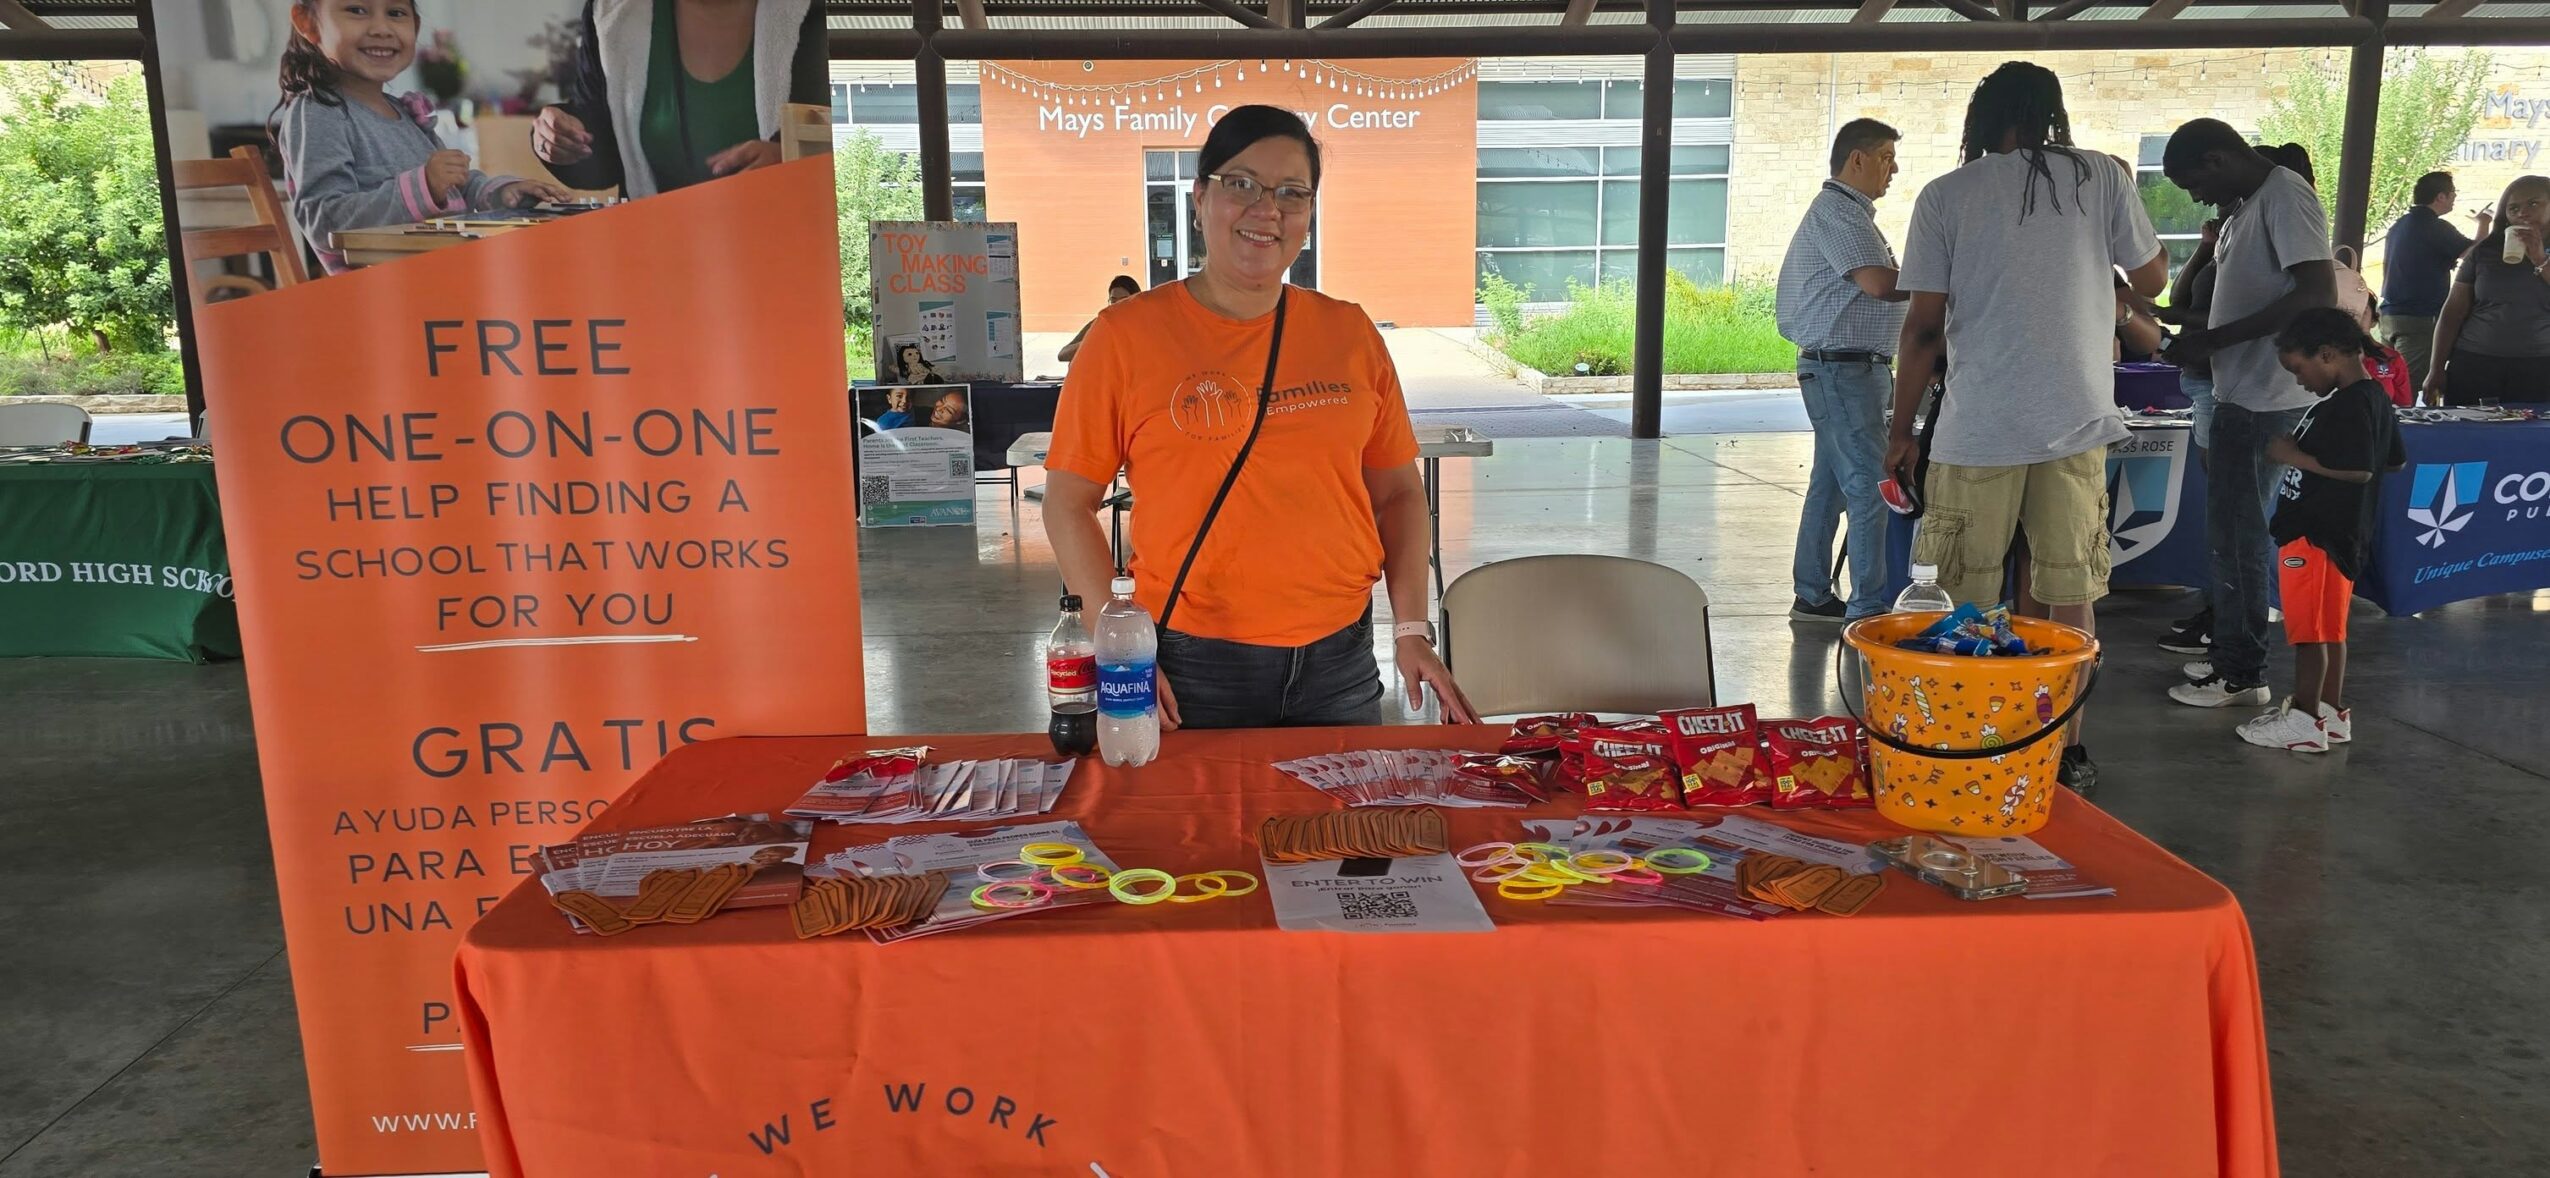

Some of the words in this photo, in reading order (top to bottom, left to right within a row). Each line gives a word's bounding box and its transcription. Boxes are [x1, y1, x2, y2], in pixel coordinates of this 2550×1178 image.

[1039, 105, 1104, 138] Mays
[1115, 104, 1197, 138] Family
[1327, 104, 1420, 129] Center
[882, 233, 928, 254] TOY
[902, 254, 988, 275] MAKING
[889, 273, 966, 294] CLASS
[424, 319, 631, 377] FREE
[1266, 396, 1348, 416] Empowered
[280, 407, 781, 464] ONE-ON-ONE
[2141, 441, 2174, 452] ROSE
[327, 485, 459, 522] HELP
[488, 480, 690, 517] FINDING
[718, 479, 749, 513] A
[2506, 506, 2550, 521] PU
[295, 544, 487, 580] SCHOOL
[495, 541, 615, 573] THAT
[626, 538, 790, 571] WORKS
[70, 562, 154, 585] HIGH
[2414, 560, 2474, 584] Unique
[438, 595, 539, 631] FOR
[566, 592, 674, 627] YOU
[1101, 681, 1151, 696] AQUAFINA
[334, 804, 476, 836] AYUDA
[622, 840, 681, 850] HOY
[349, 848, 485, 883] PARA
[1291, 879, 1361, 888] ENTER
[1365, 877, 1395, 885] TO
[1400, 875, 1443, 883] WIN
[345, 901, 452, 934] UNA
[748, 1098, 836, 1155] WE
[884, 1082, 1057, 1148] WORK
